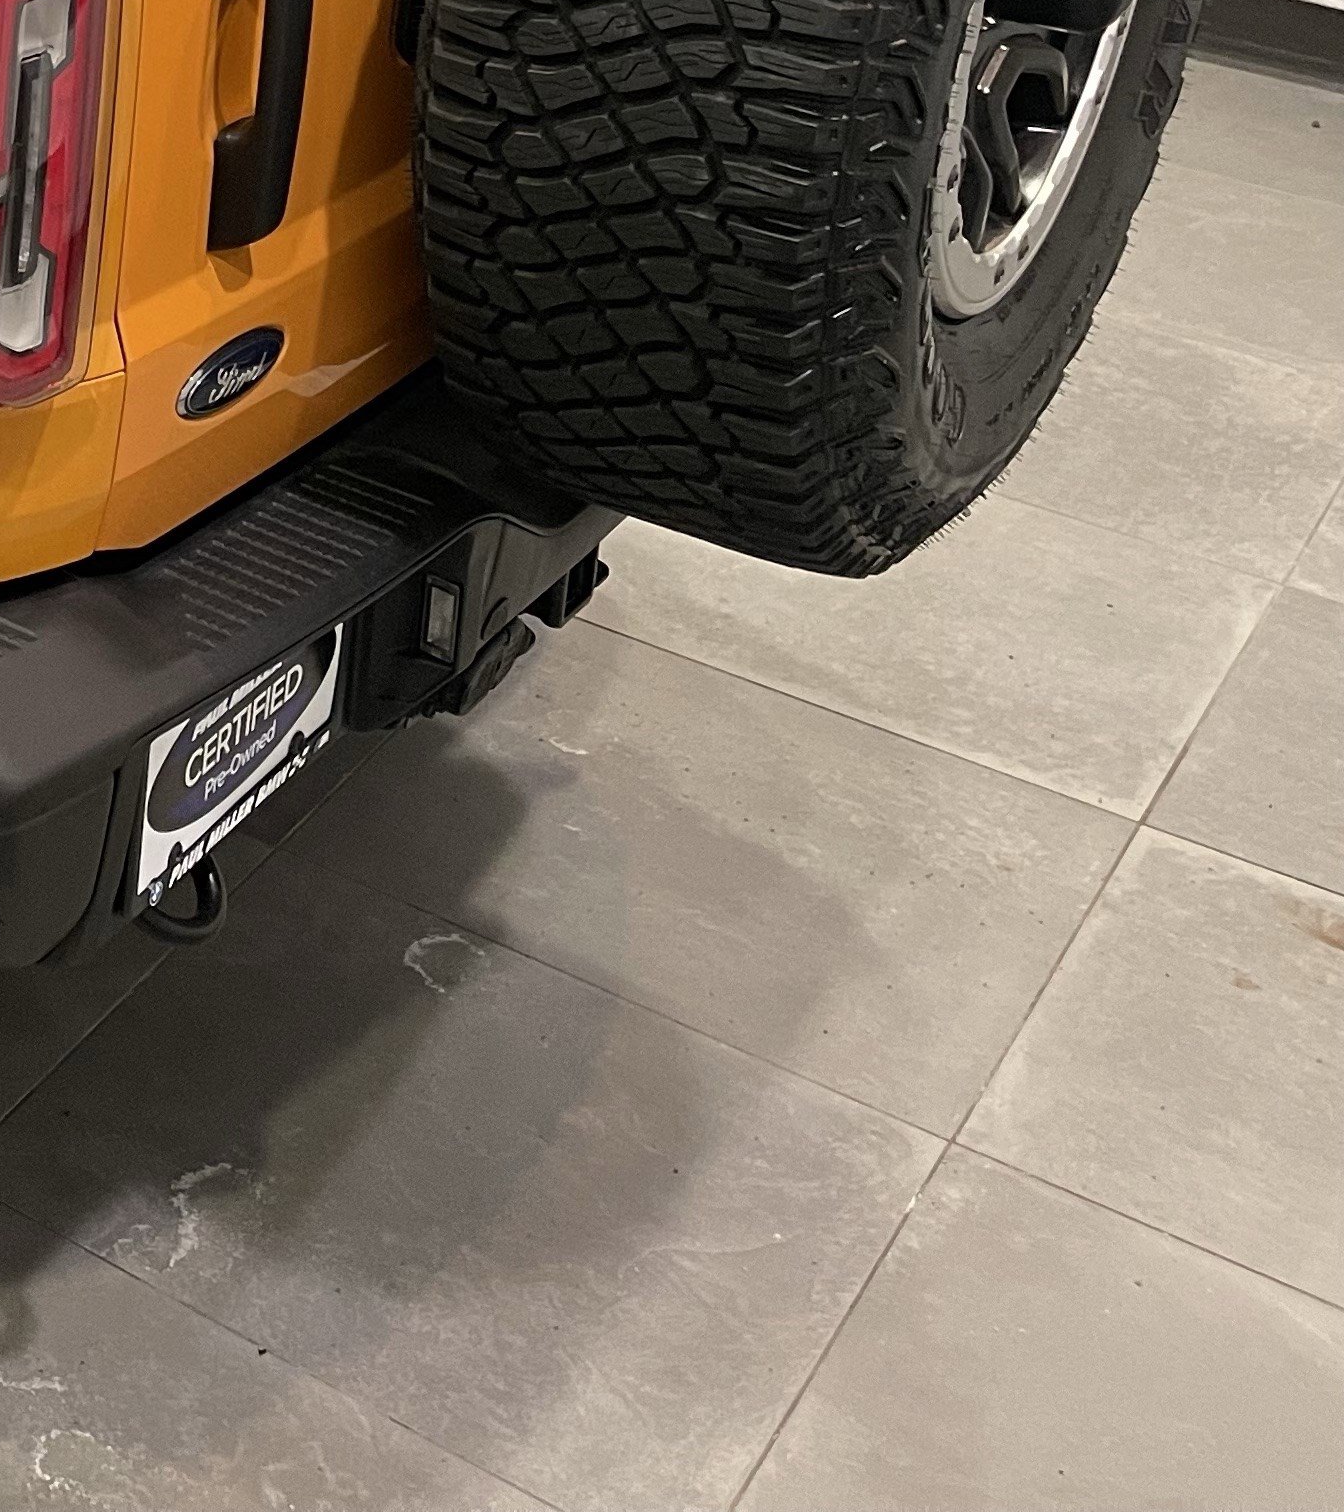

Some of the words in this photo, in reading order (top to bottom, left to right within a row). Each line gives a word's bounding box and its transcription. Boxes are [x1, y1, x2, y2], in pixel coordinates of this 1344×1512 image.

[208, 351, 267, 404] Ford
[184, 663, 304, 788] CERTIFIED
[203, 718, 277, 802] Pre-Owned
[168, 840, 206, 889] PAUL
[205, 794, 256, 854] MILLER
